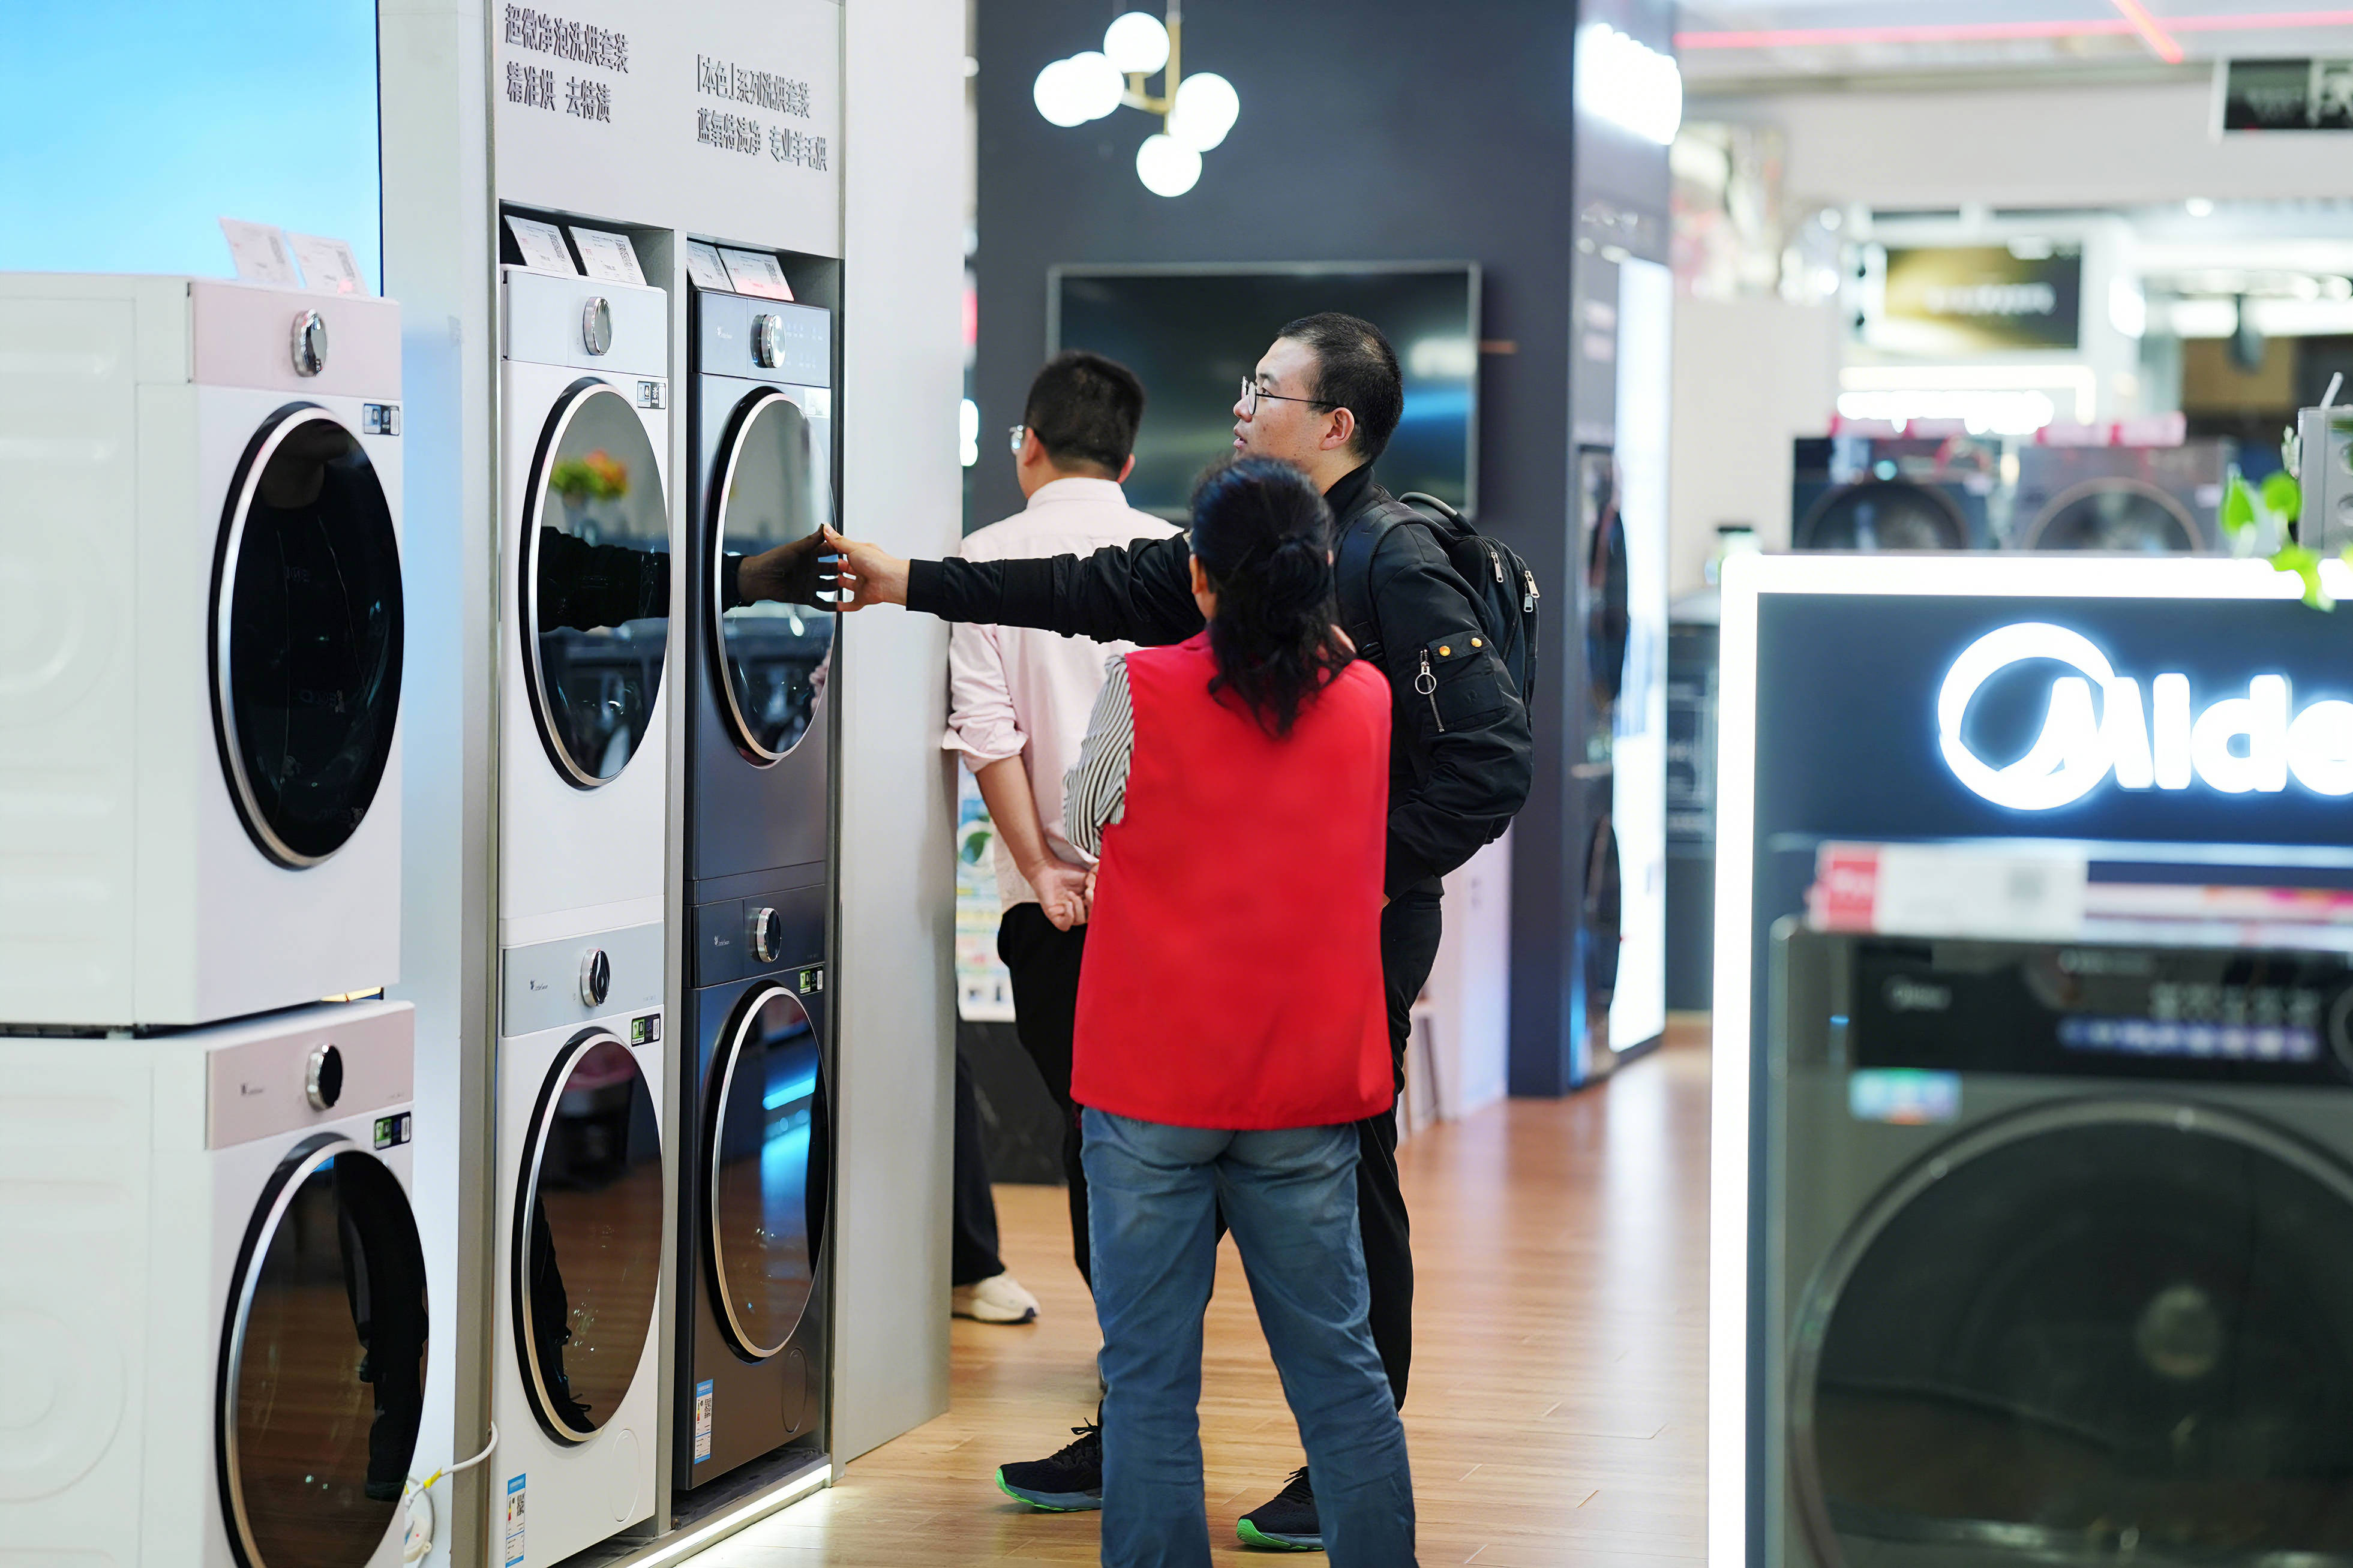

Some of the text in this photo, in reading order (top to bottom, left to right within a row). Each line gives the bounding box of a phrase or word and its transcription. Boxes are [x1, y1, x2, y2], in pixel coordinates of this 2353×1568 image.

[505, 3, 629, 73] 超微净泡洗烘套装
[507, 61, 611, 123] 精准烘 去特渍
[697, 107, 827, 171] 蓝氧特渍净 专业羊毛烘
